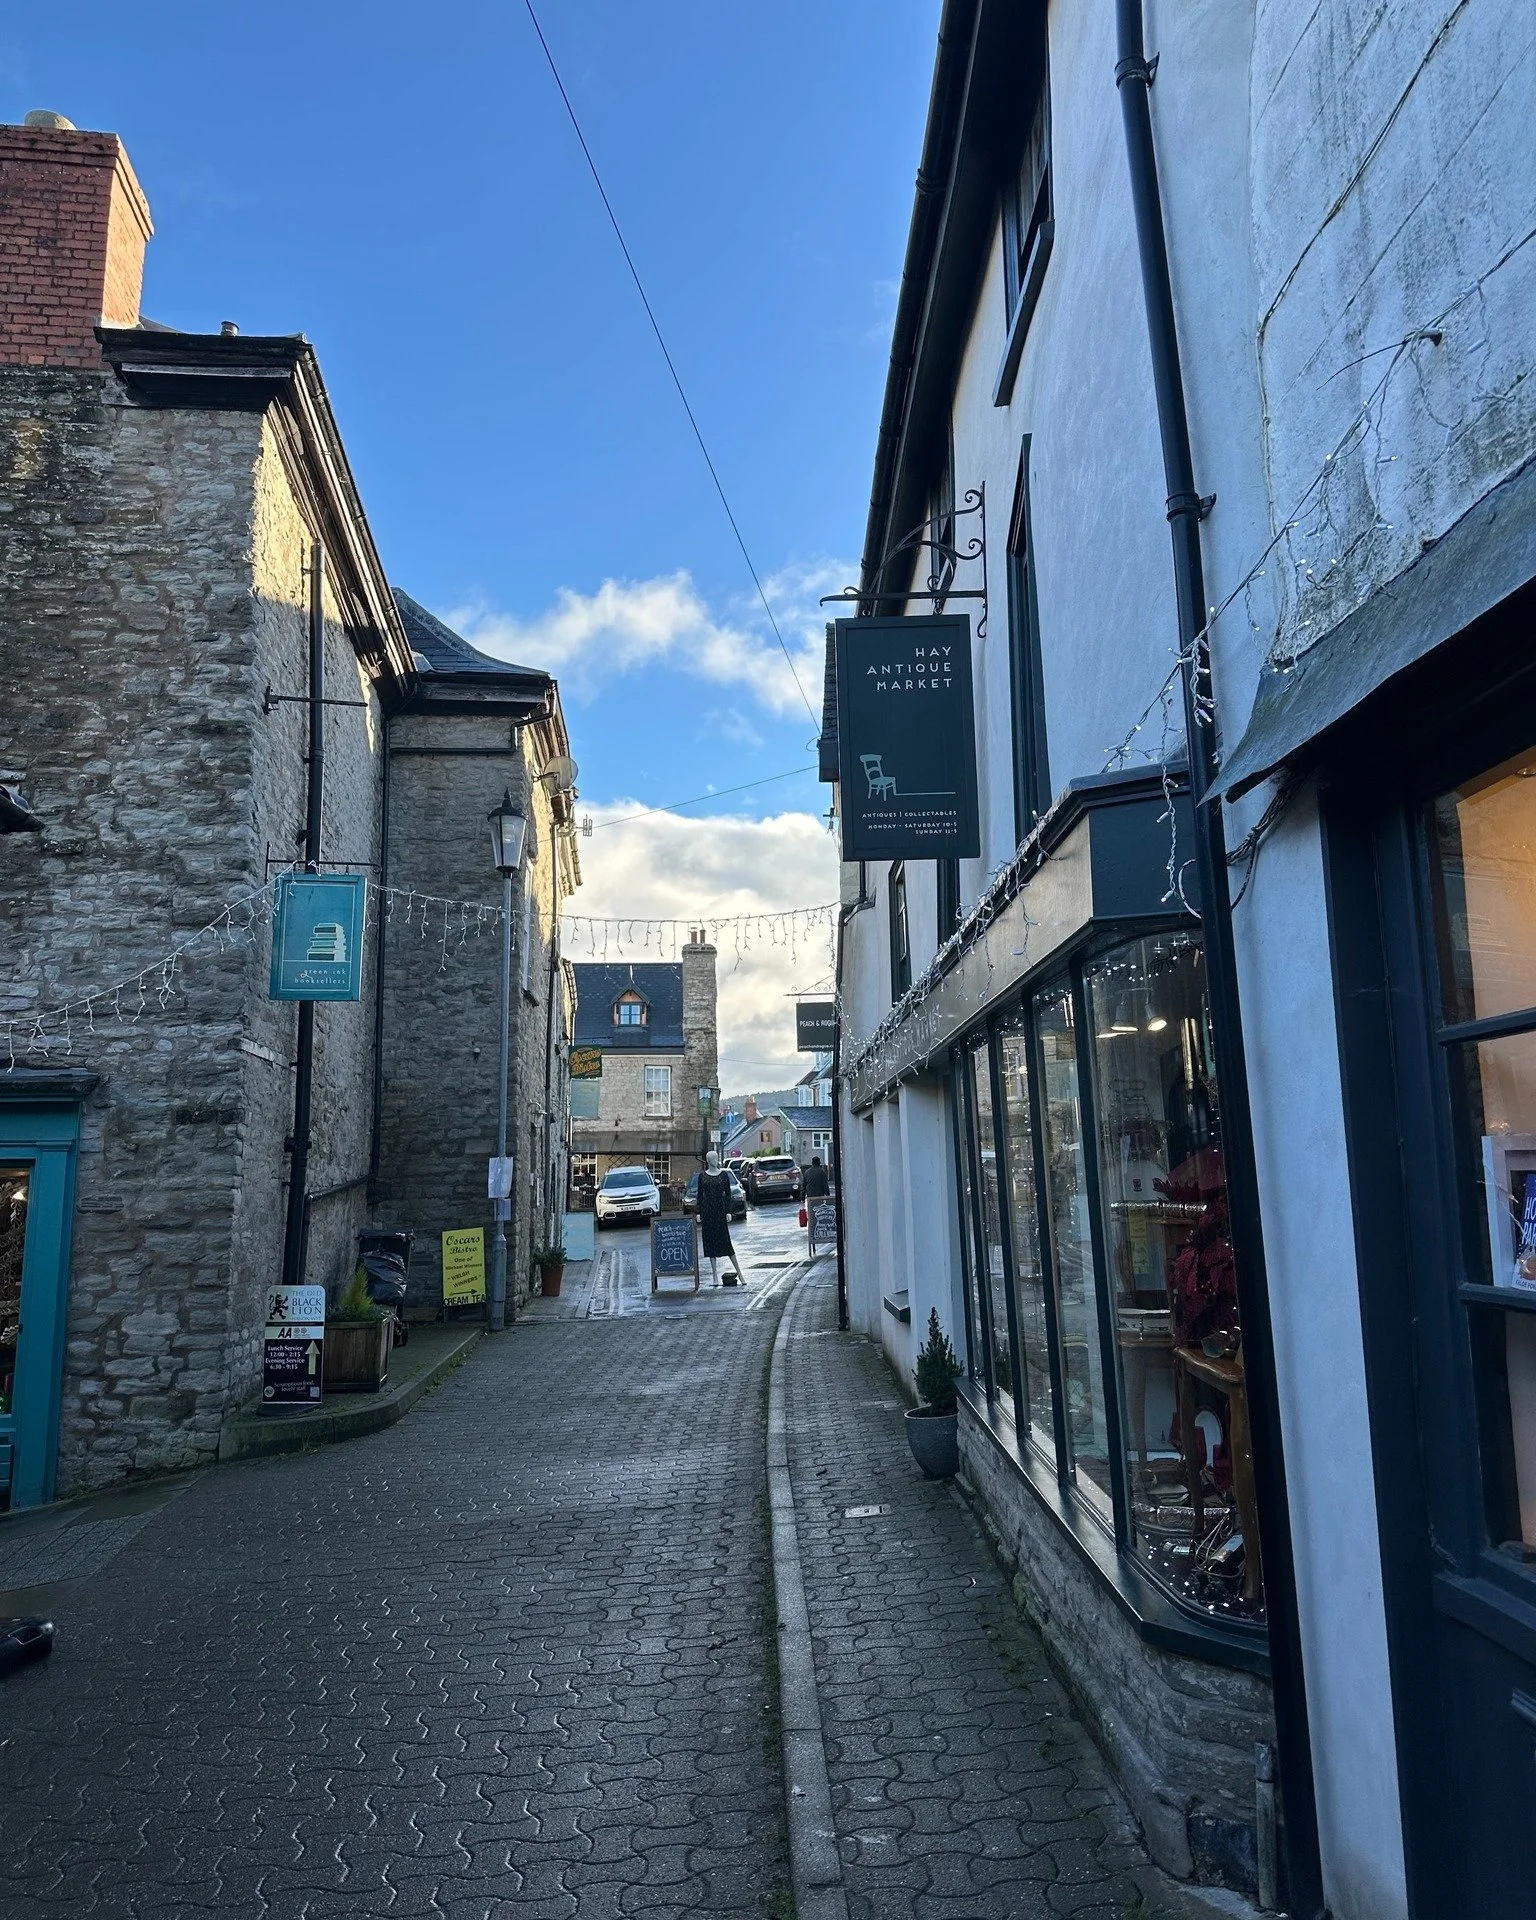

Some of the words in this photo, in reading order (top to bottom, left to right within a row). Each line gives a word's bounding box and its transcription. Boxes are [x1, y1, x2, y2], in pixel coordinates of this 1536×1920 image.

[915, 646, 951, 657] HAY
[867, 662, 951, 675] ANTIQUE
[877, 678, 952, 690] MARKET
[300, 969, 328, 979] green
[799, 1020, 815, 1028] PEACH
[446, 1235, 480, 1246] Oscars
[449, 1246, 477, 1254] Bistro
[660, 1247, 689, 1262] OPEN
[292, 1297, 322, 1306] BLACK
[292, 1306, 322, 1315] LION
[277, 1327, 292, 1339] AA
